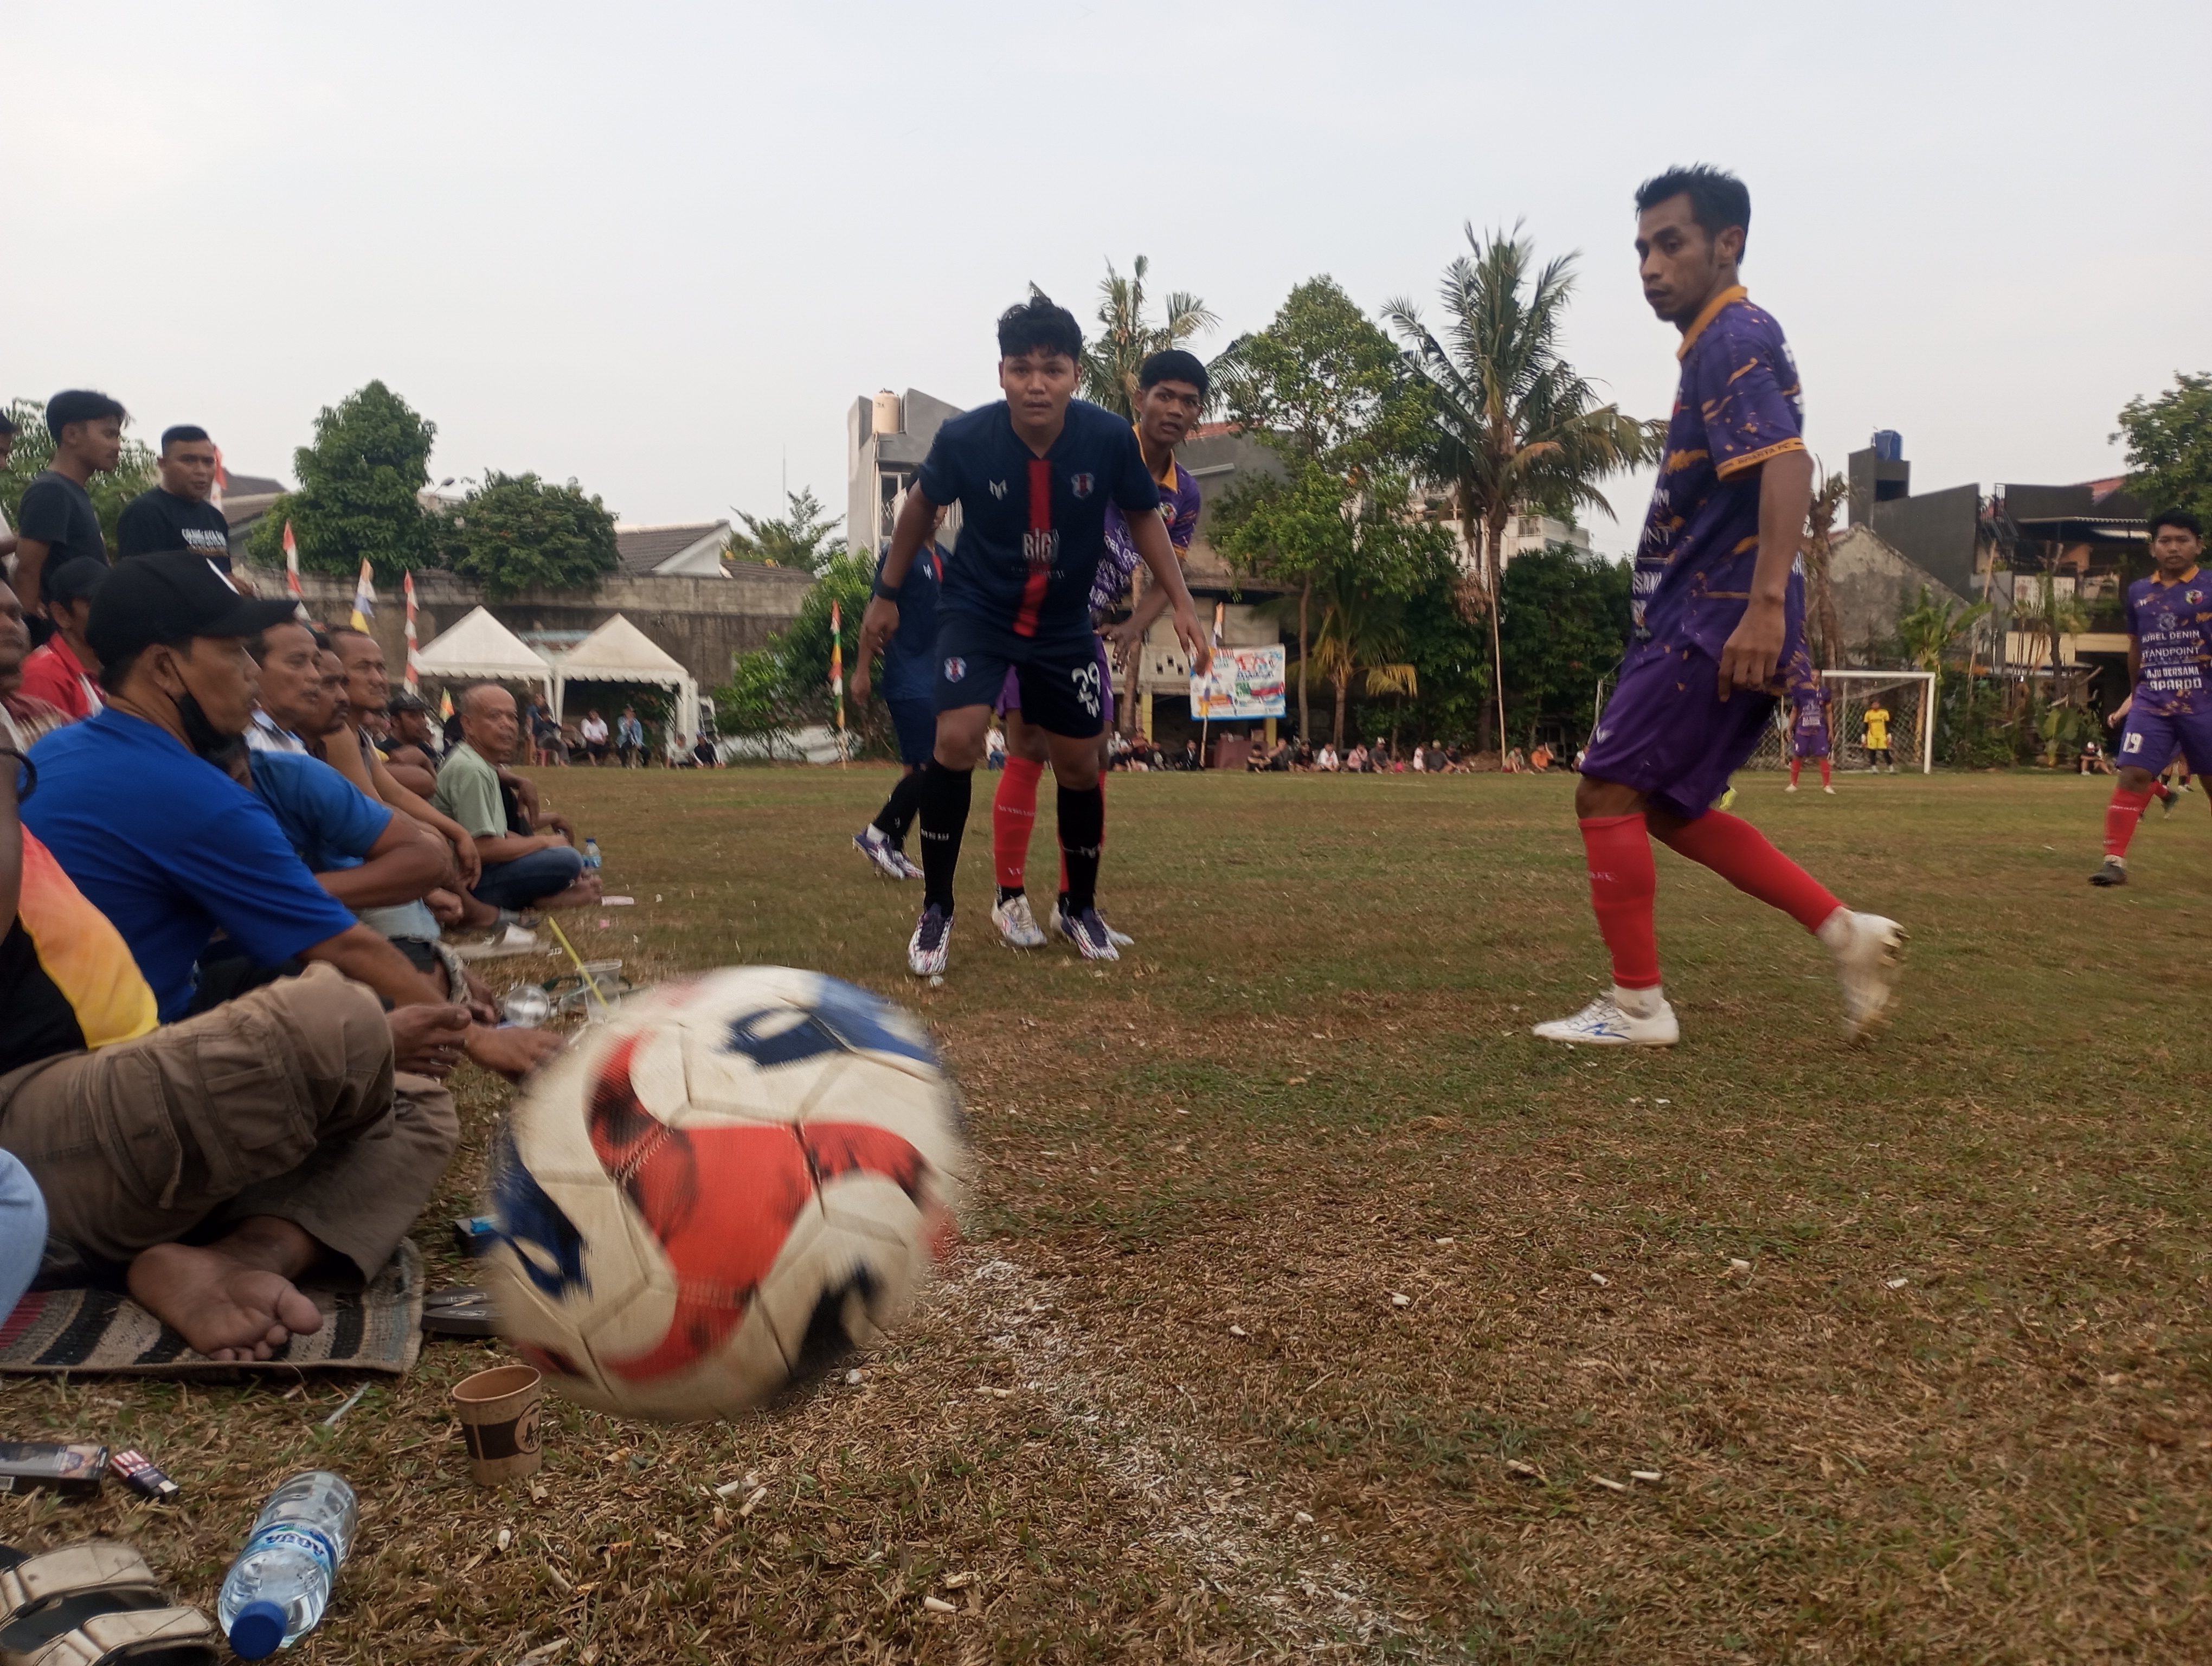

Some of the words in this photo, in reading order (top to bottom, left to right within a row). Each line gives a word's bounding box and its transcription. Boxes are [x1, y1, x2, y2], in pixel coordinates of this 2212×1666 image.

[2169, 630, 2200, 640] DENIM
[2144, 668, 2162, 678] AJU
[2148, 677, 2202, 691] APARDO
[2123, 732, 2143, 754] 19
[265, 1532, 325, 1557] AQUA
